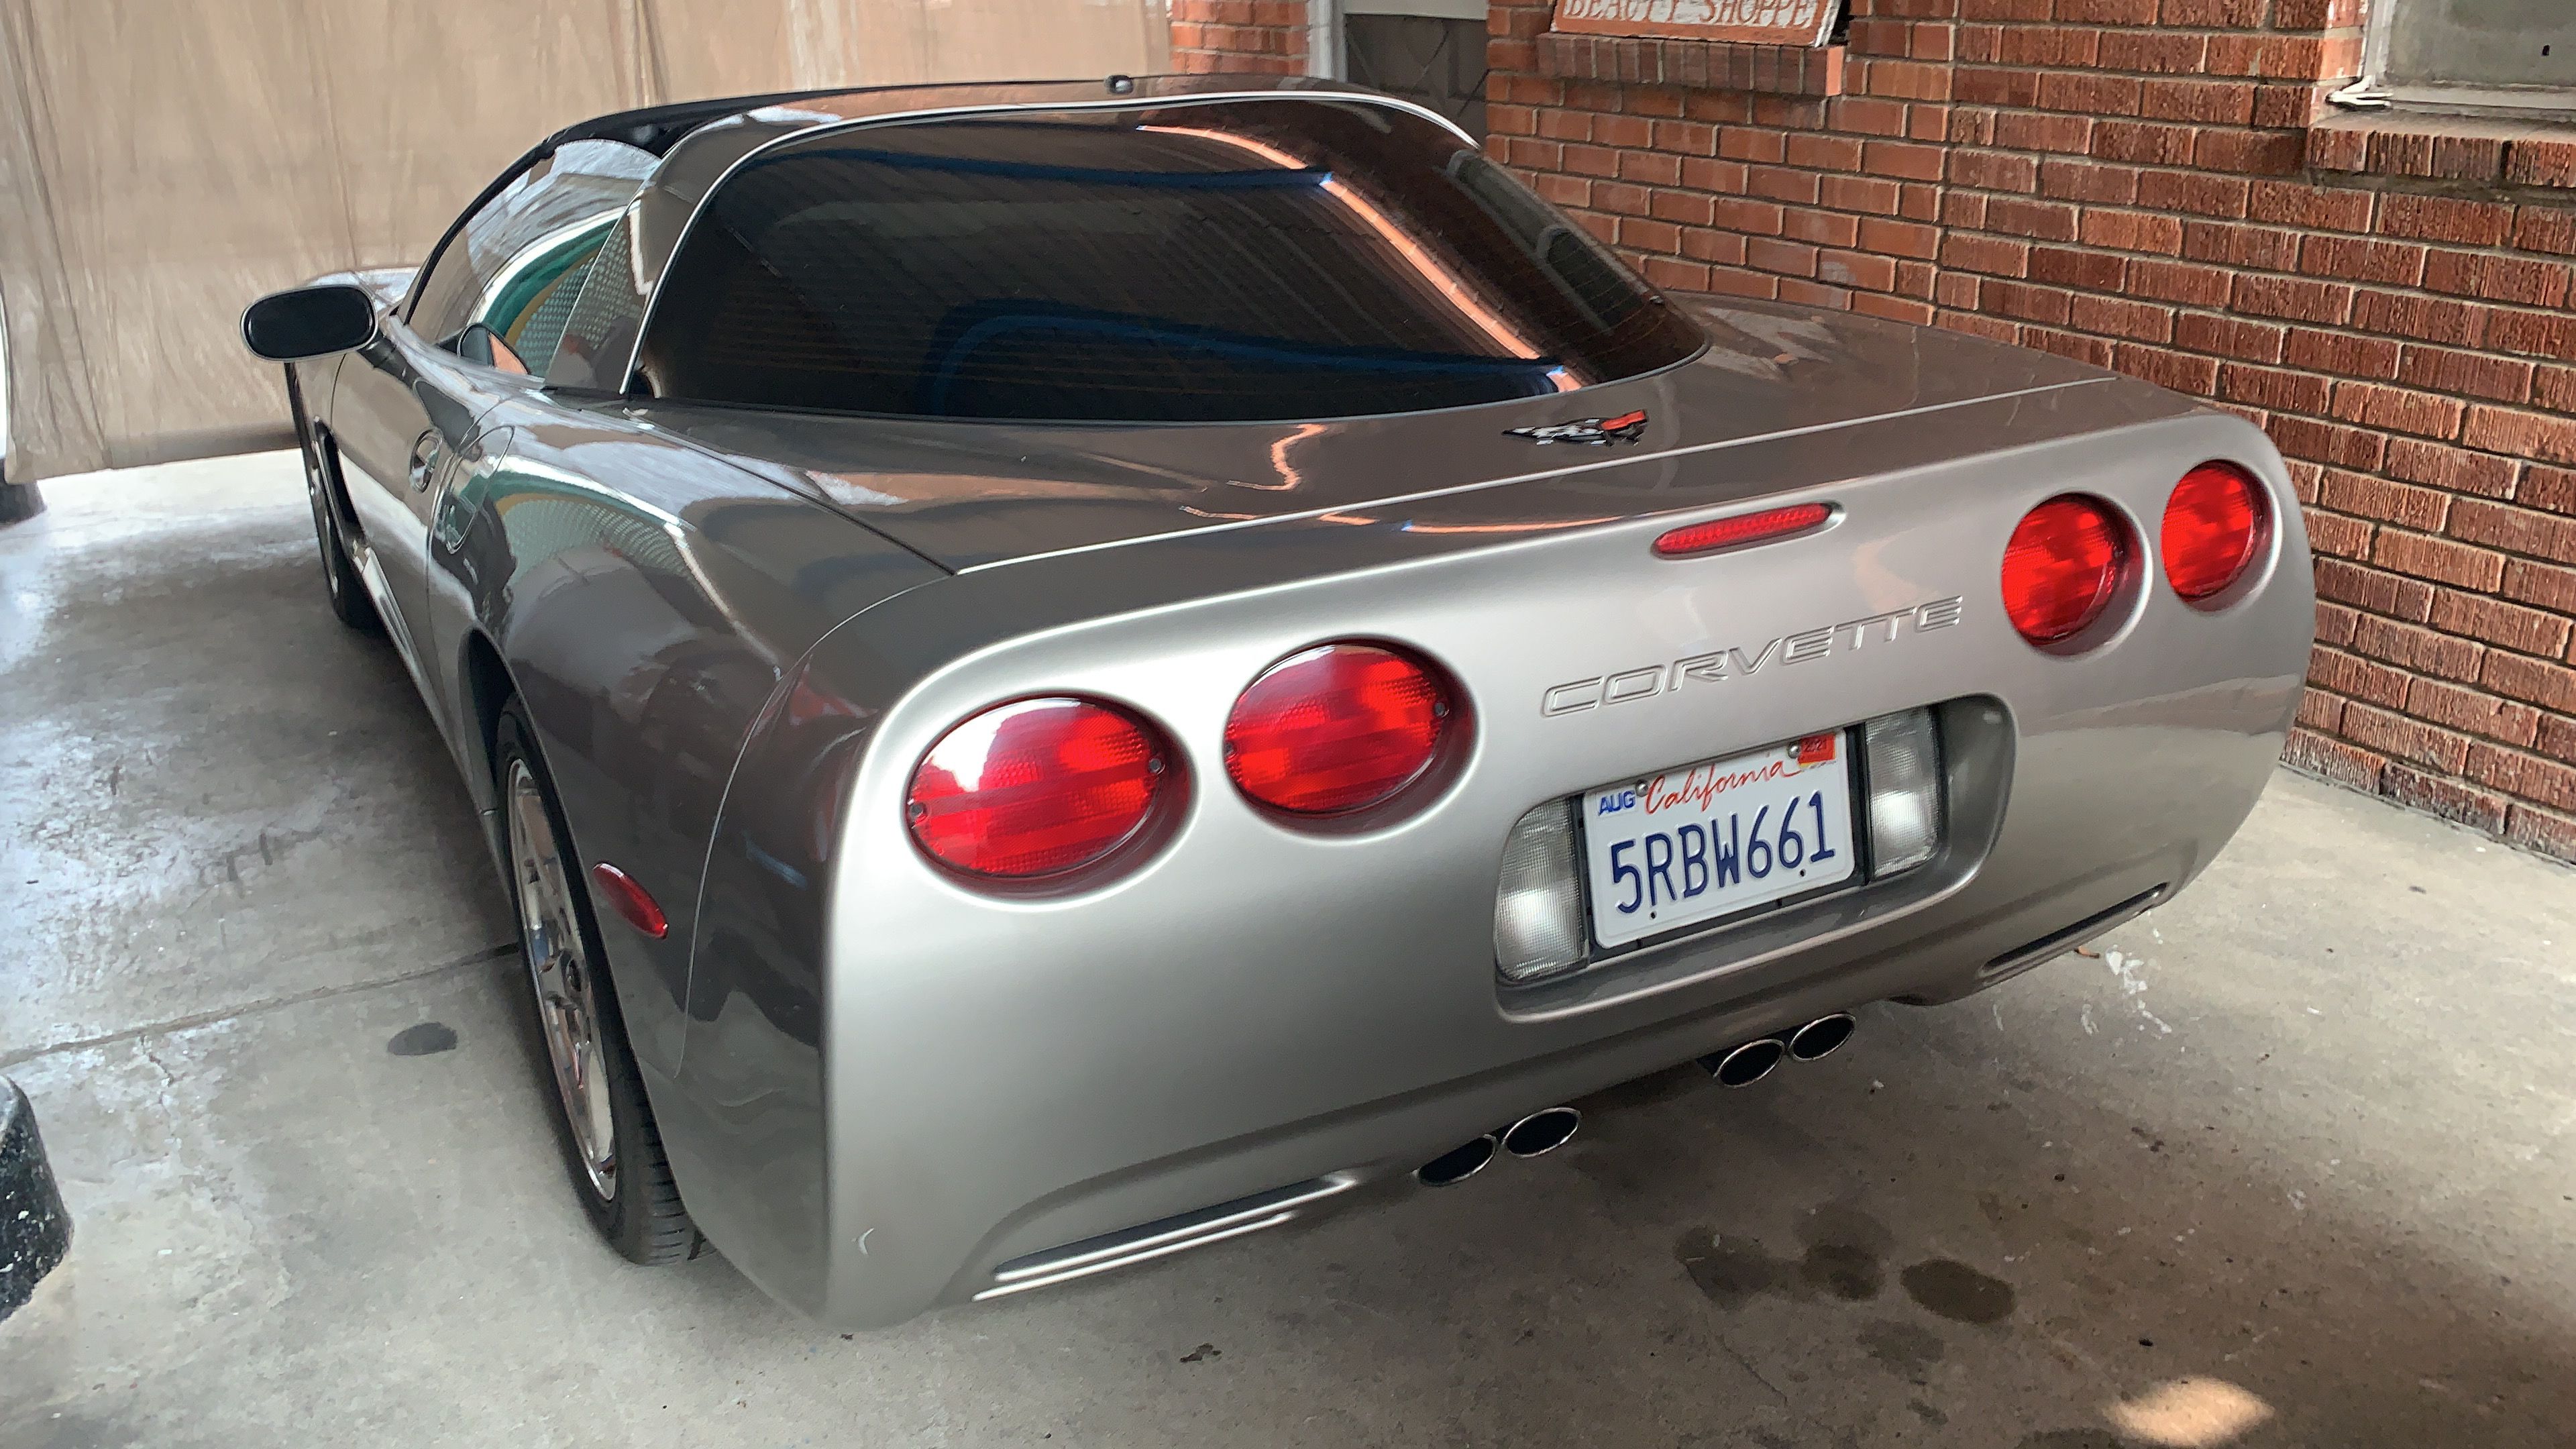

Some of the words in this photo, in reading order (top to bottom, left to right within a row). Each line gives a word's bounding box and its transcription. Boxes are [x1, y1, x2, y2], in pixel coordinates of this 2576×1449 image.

[1542, 595, 1963, 717] CORVETTE
[1598, 790, 1636, 816] AUG
[1646, 761, 1803, 814] California
[1610, 791, 1836, 914] 5RBW661
